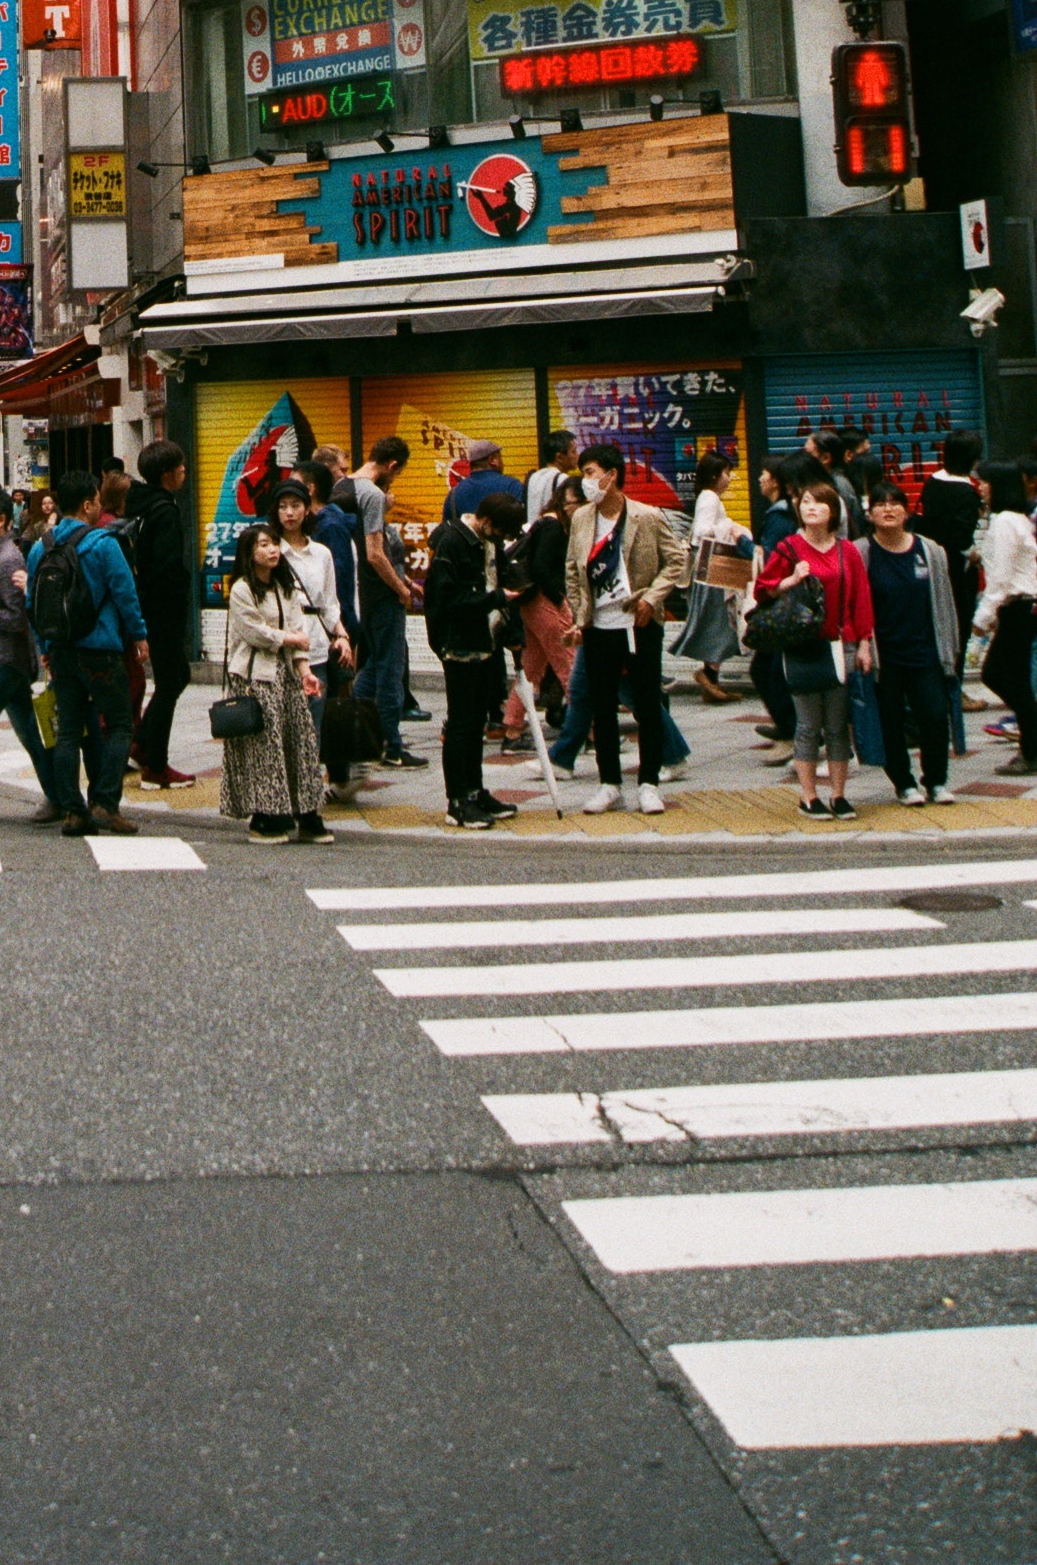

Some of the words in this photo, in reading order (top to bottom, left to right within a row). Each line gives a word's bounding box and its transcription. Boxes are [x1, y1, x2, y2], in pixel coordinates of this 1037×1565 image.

[83, 155, 110, 168] 2F
[352, 164, 451, 186] NATURAL
[352, 181, 452, 208] AMERICAN
[352, 204, 452, 244] SPIRIT
[795, 389, 952, 412] NATURAL
